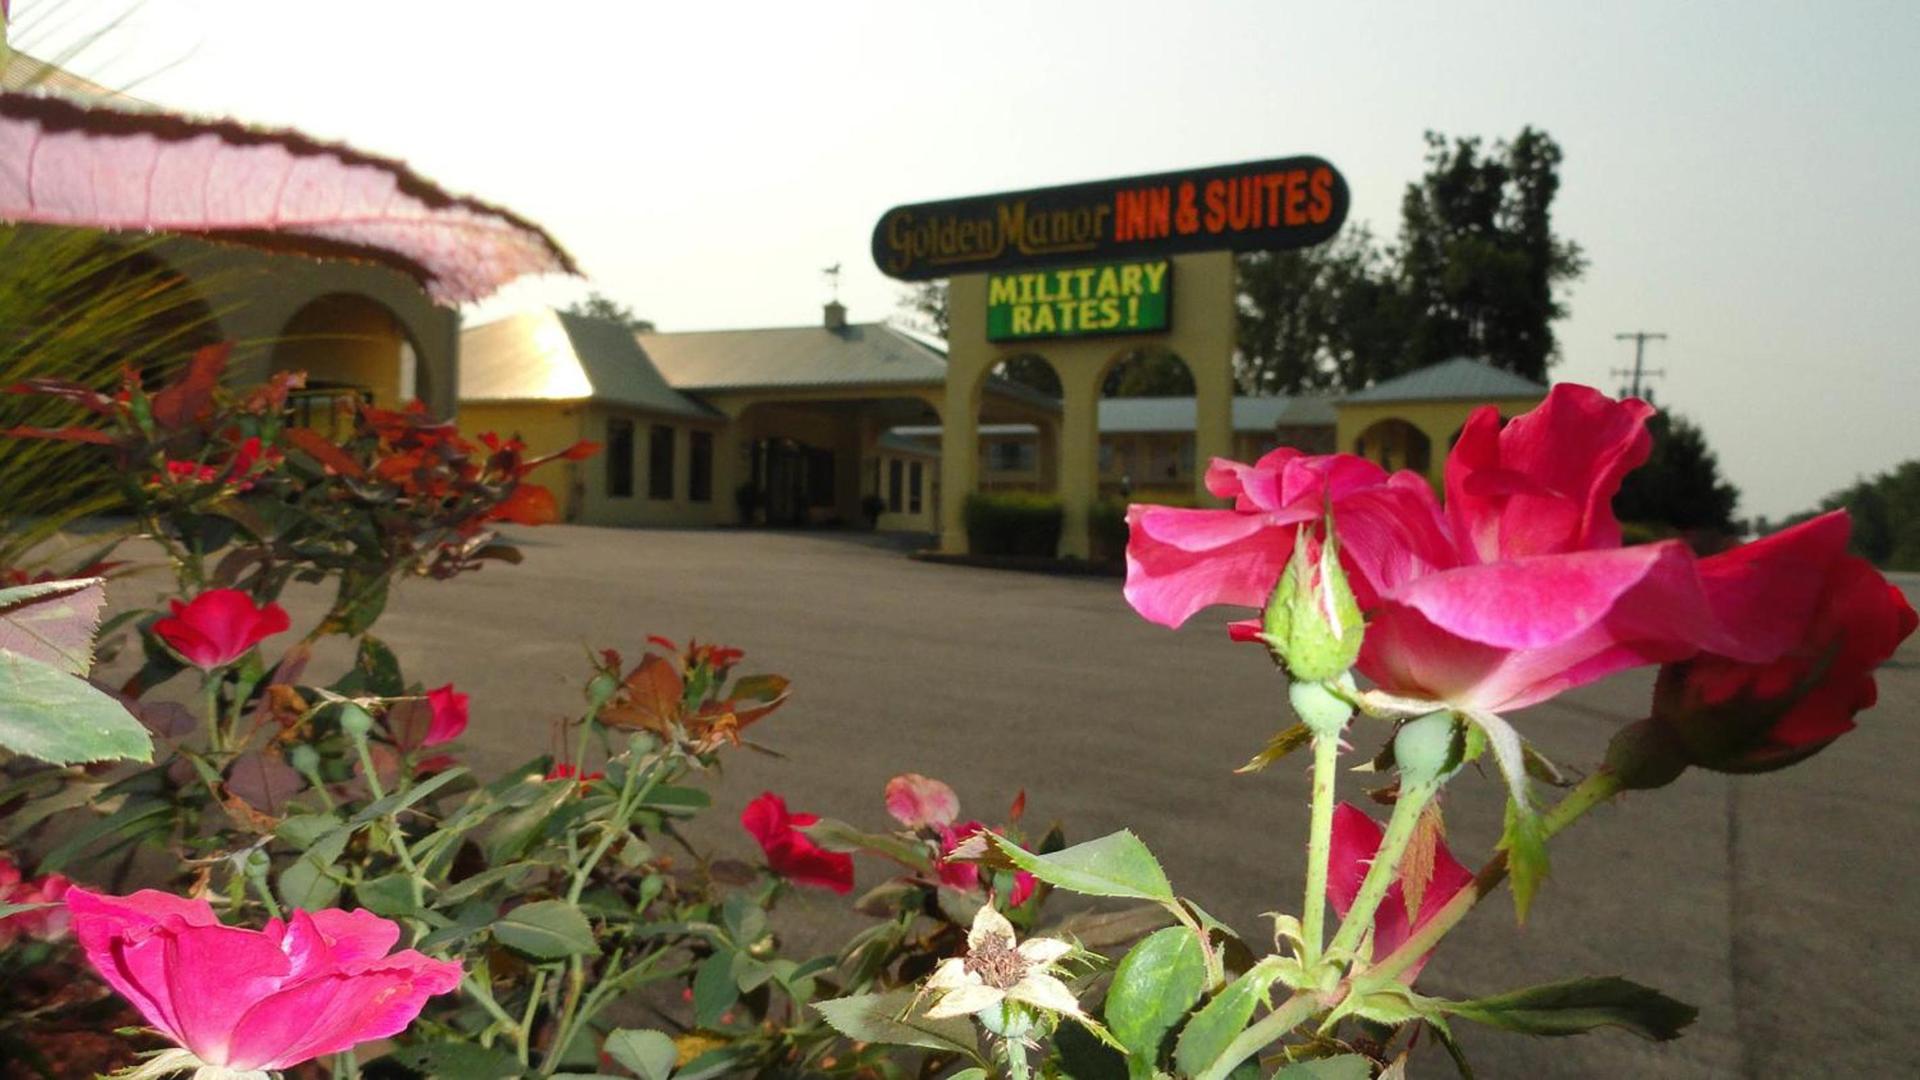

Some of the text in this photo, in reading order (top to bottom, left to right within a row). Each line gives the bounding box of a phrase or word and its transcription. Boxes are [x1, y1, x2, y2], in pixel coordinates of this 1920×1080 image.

[888, 166, 1334, 272] Golden Manor INN & SUITES
[989, 260, 1169, 307] MILITARY
[1011, 295, 1139, 336] RATES!
